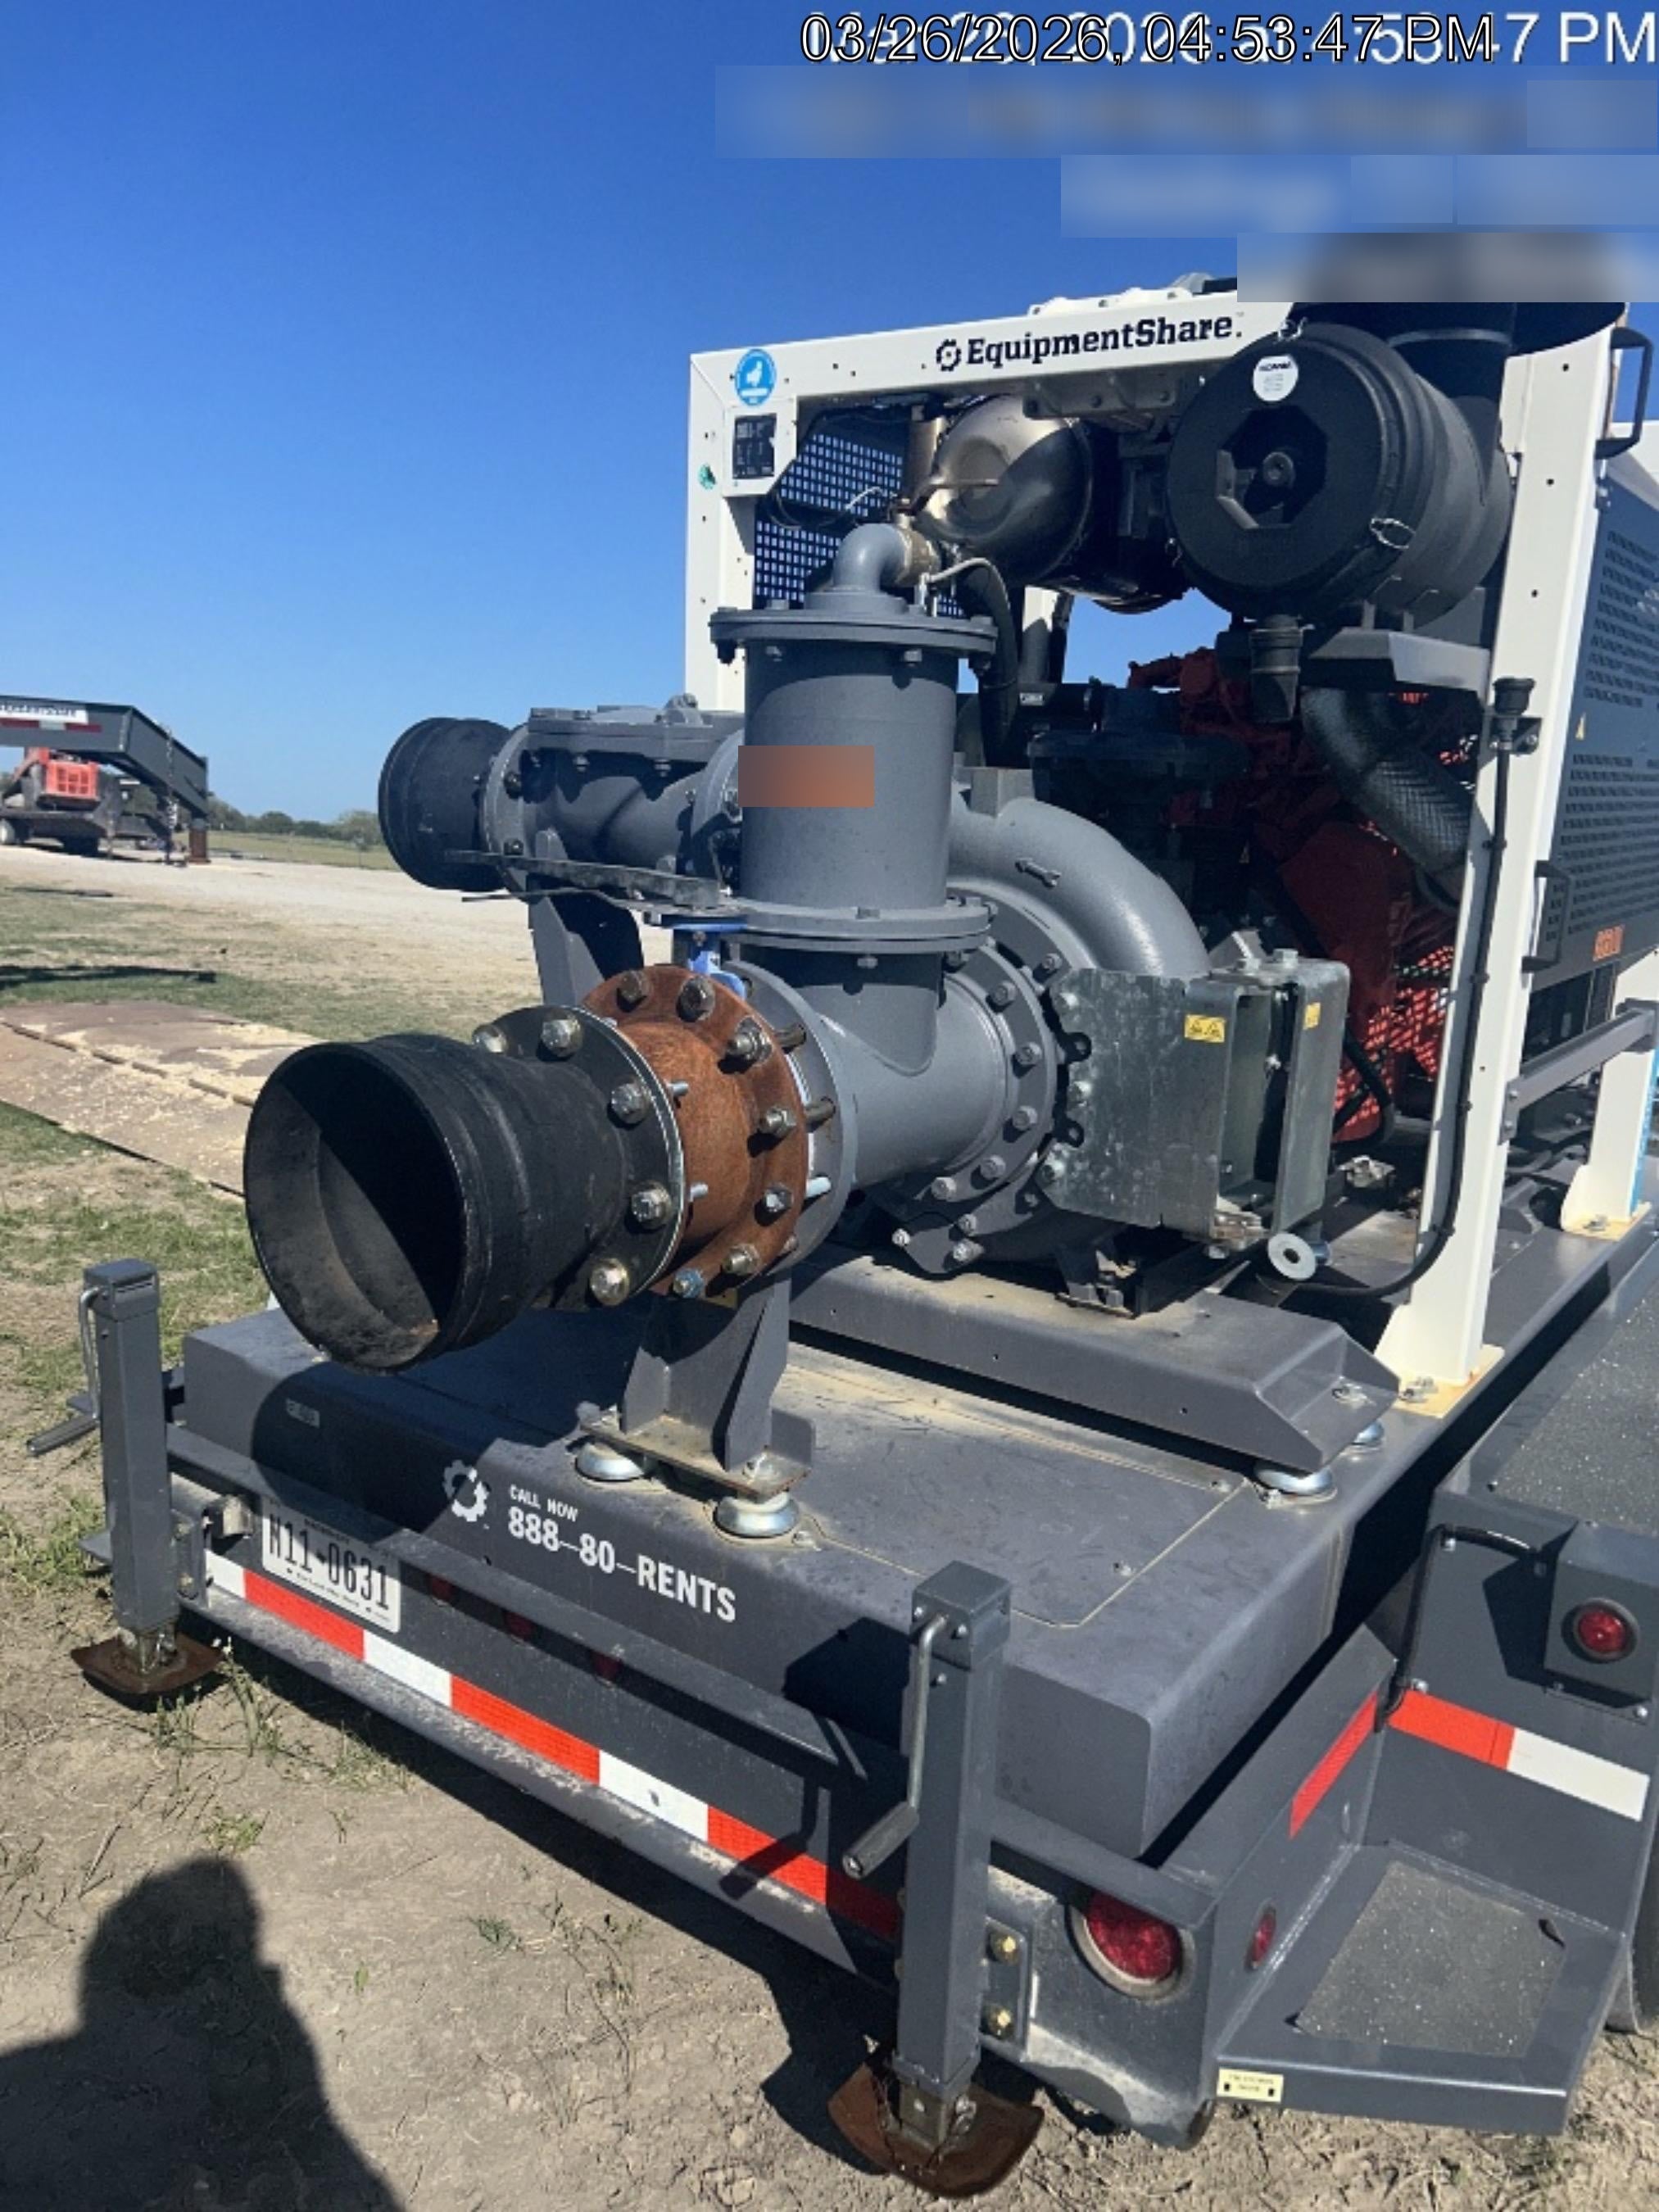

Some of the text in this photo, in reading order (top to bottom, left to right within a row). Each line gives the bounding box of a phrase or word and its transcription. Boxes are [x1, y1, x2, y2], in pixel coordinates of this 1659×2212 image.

[966, 315, 1233, 369] EquipmentShare
[510, 1484, 579, 1522] CALL NOW
[507, 1506, 737, 1623] 888-80-RENTS
